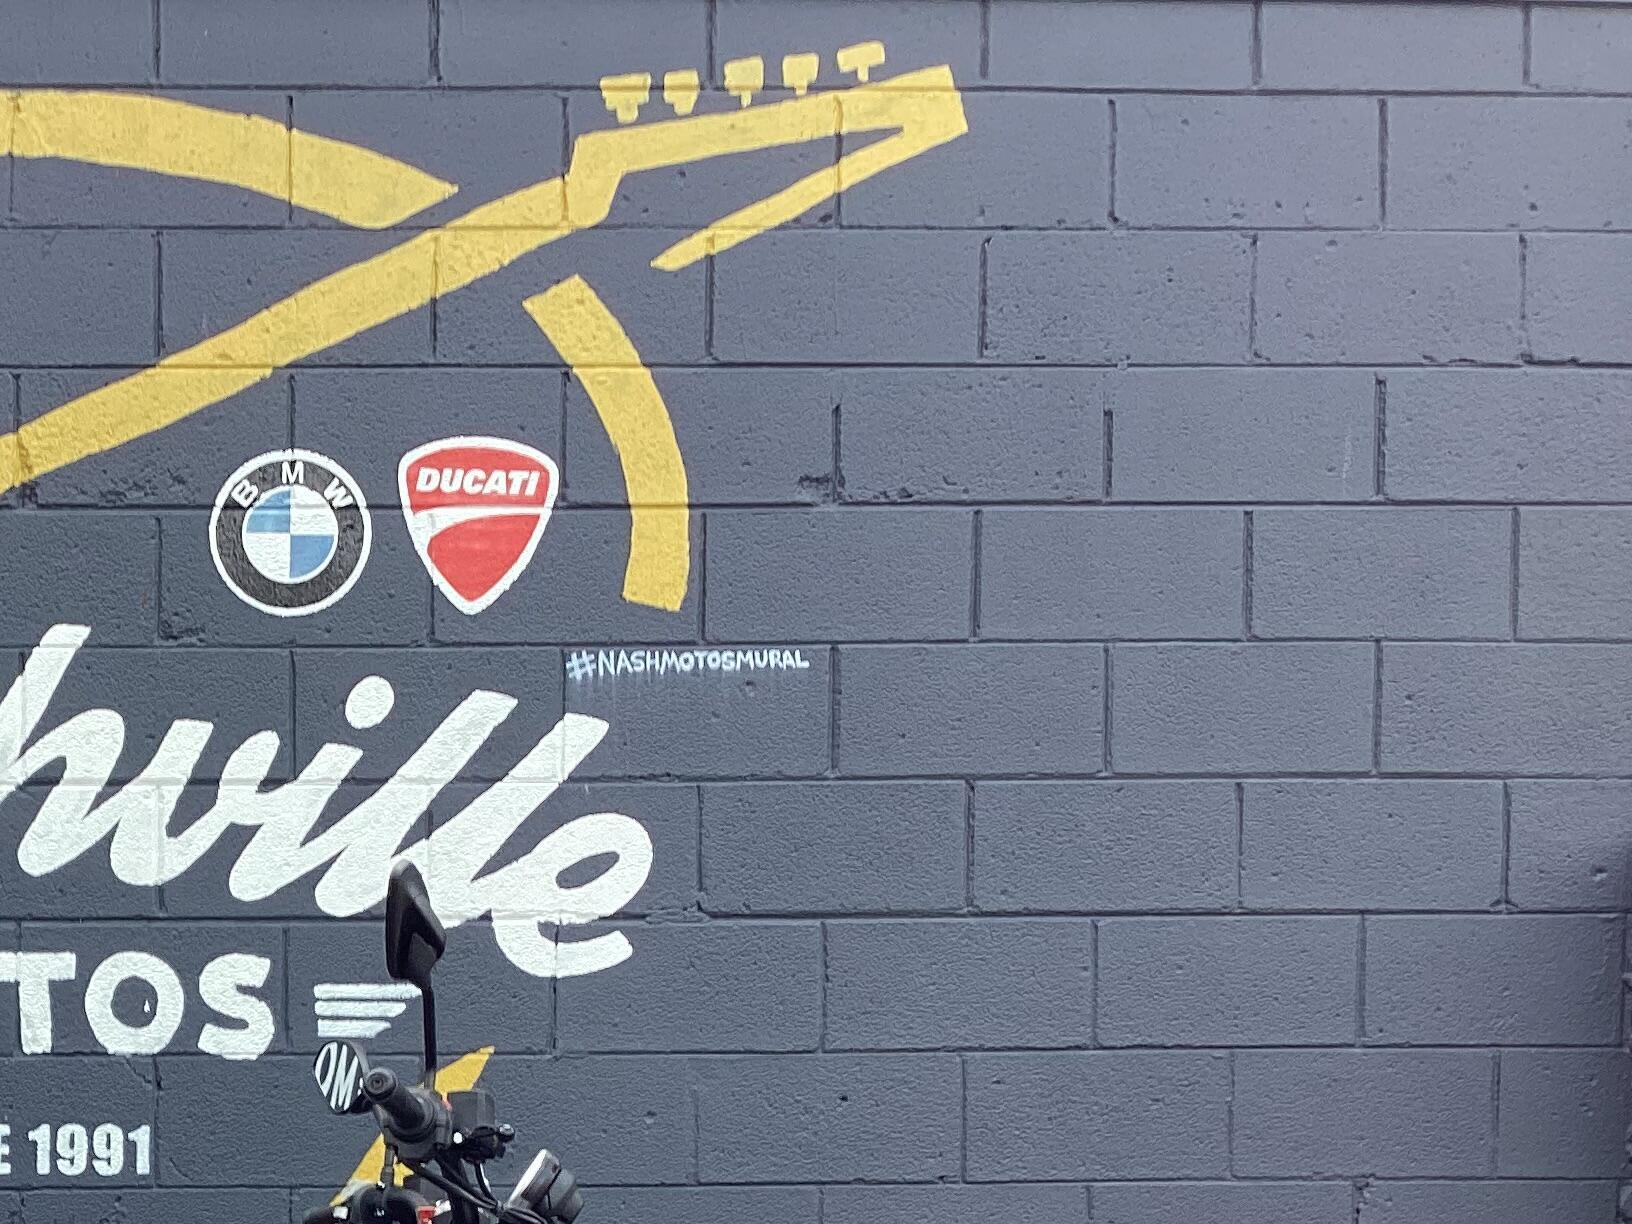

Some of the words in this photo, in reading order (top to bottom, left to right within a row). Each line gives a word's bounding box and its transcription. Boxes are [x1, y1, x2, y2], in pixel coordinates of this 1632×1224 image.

[231, 461, 354, 510] BMW
[415, 466, 542, 497] DUCATI
[565, 648, 811, 682] #NASHMOTOSMURAL
[27, 1122, 152, 1177] 1991
